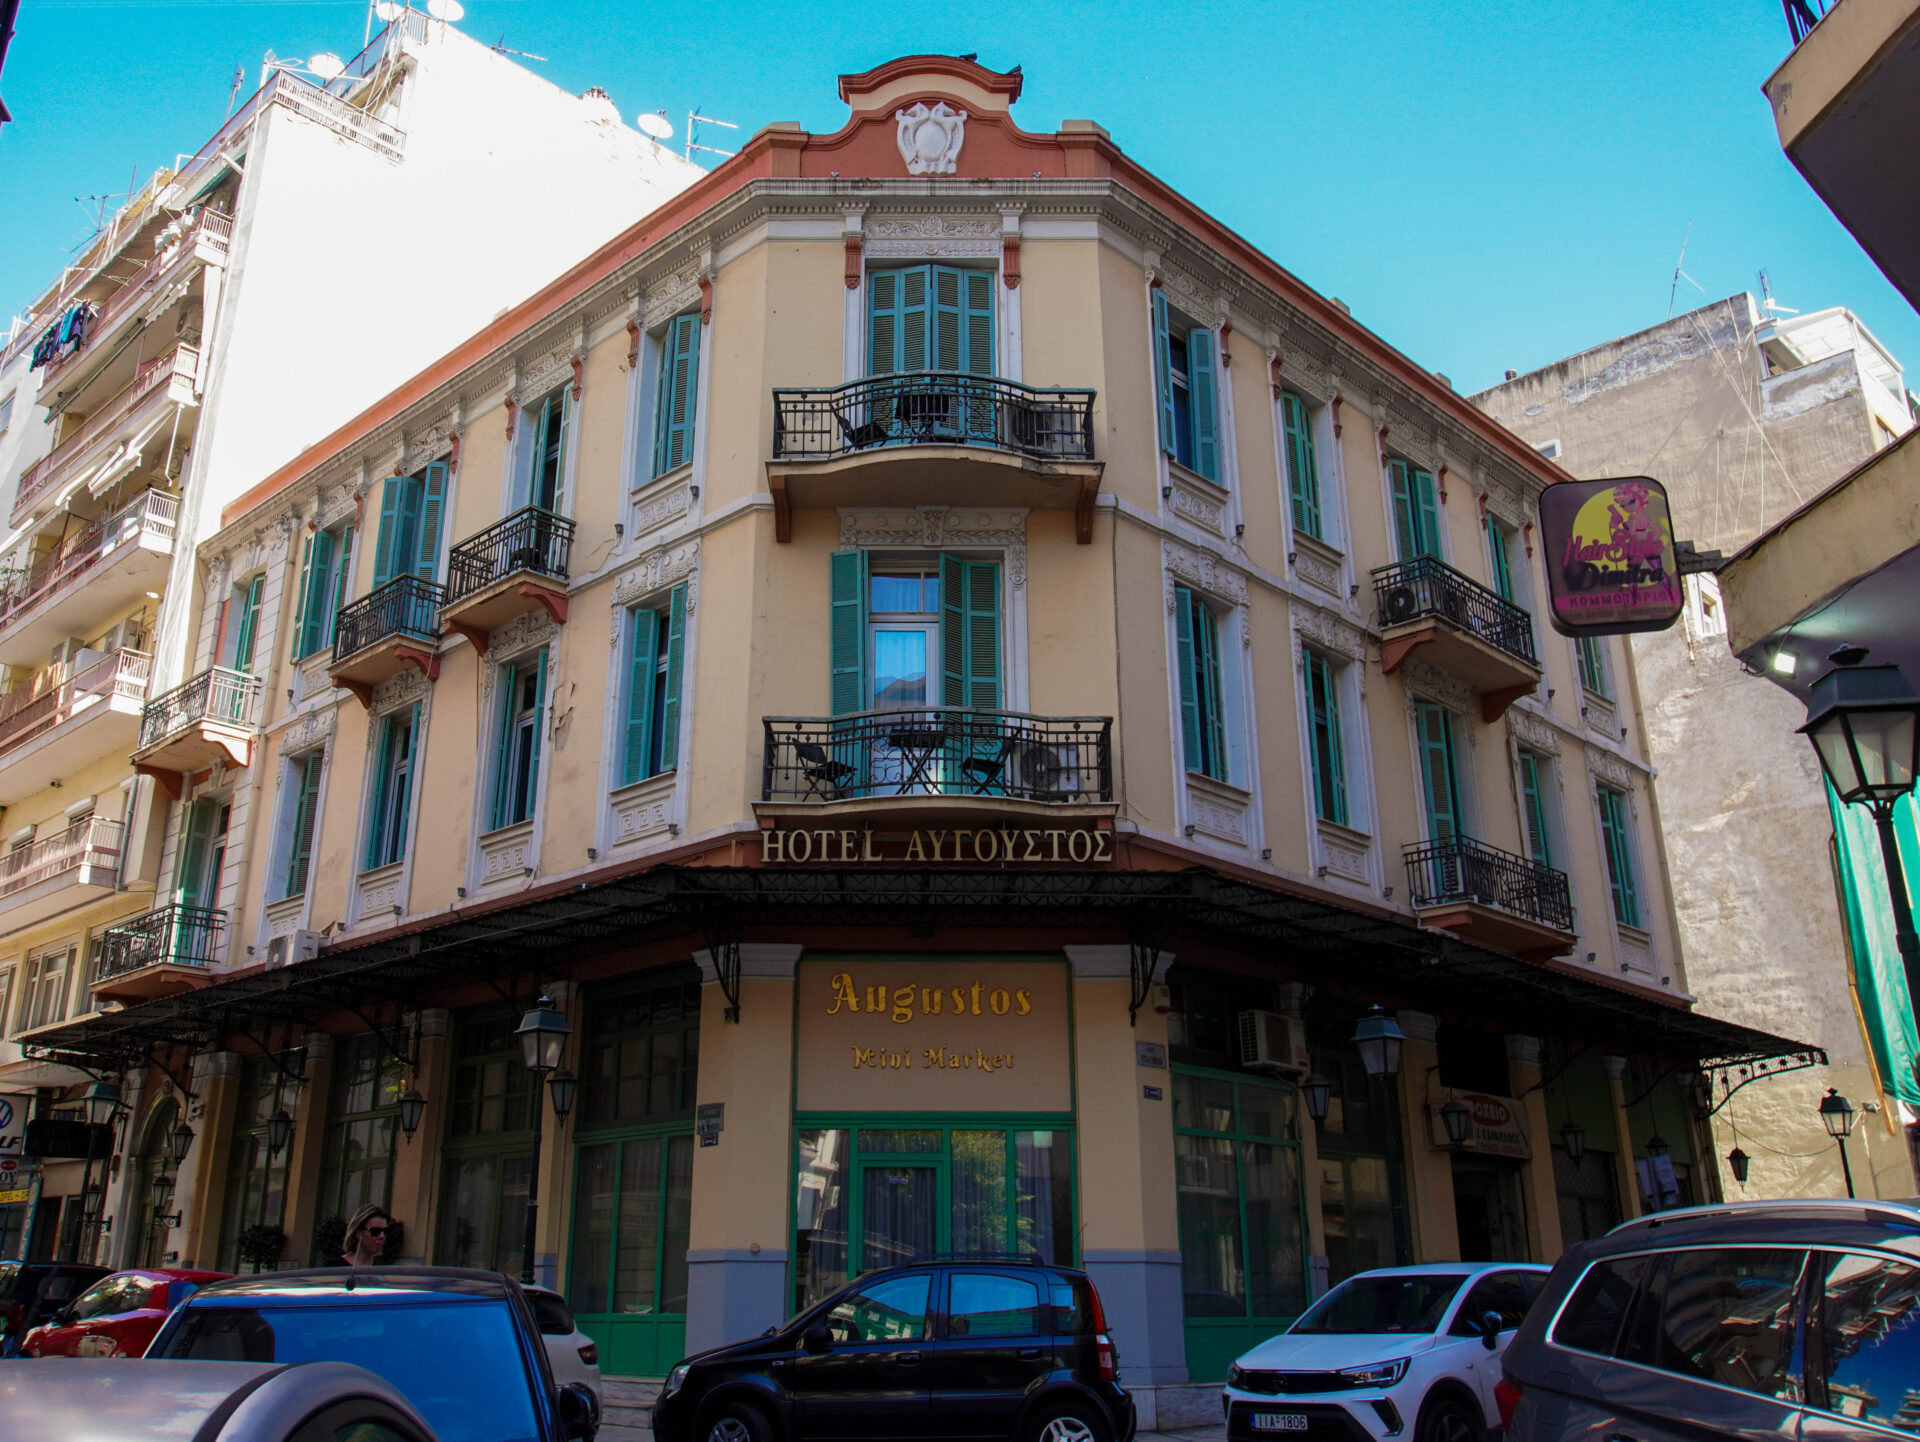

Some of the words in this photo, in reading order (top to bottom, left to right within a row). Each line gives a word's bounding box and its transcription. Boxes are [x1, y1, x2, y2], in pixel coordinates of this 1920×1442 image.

[1564, 562, 1664, 591] Dimitra
[760, 829, 882, 863] HOTEL
[904, 828, 1113, 863] ΑΥΓΟΥΣΤΟΣ
[826, 972, 1032, 1024] Augustos
[851, 1045, 911, 1070] Mini
[922, 1045, 1015, 1073] Market
